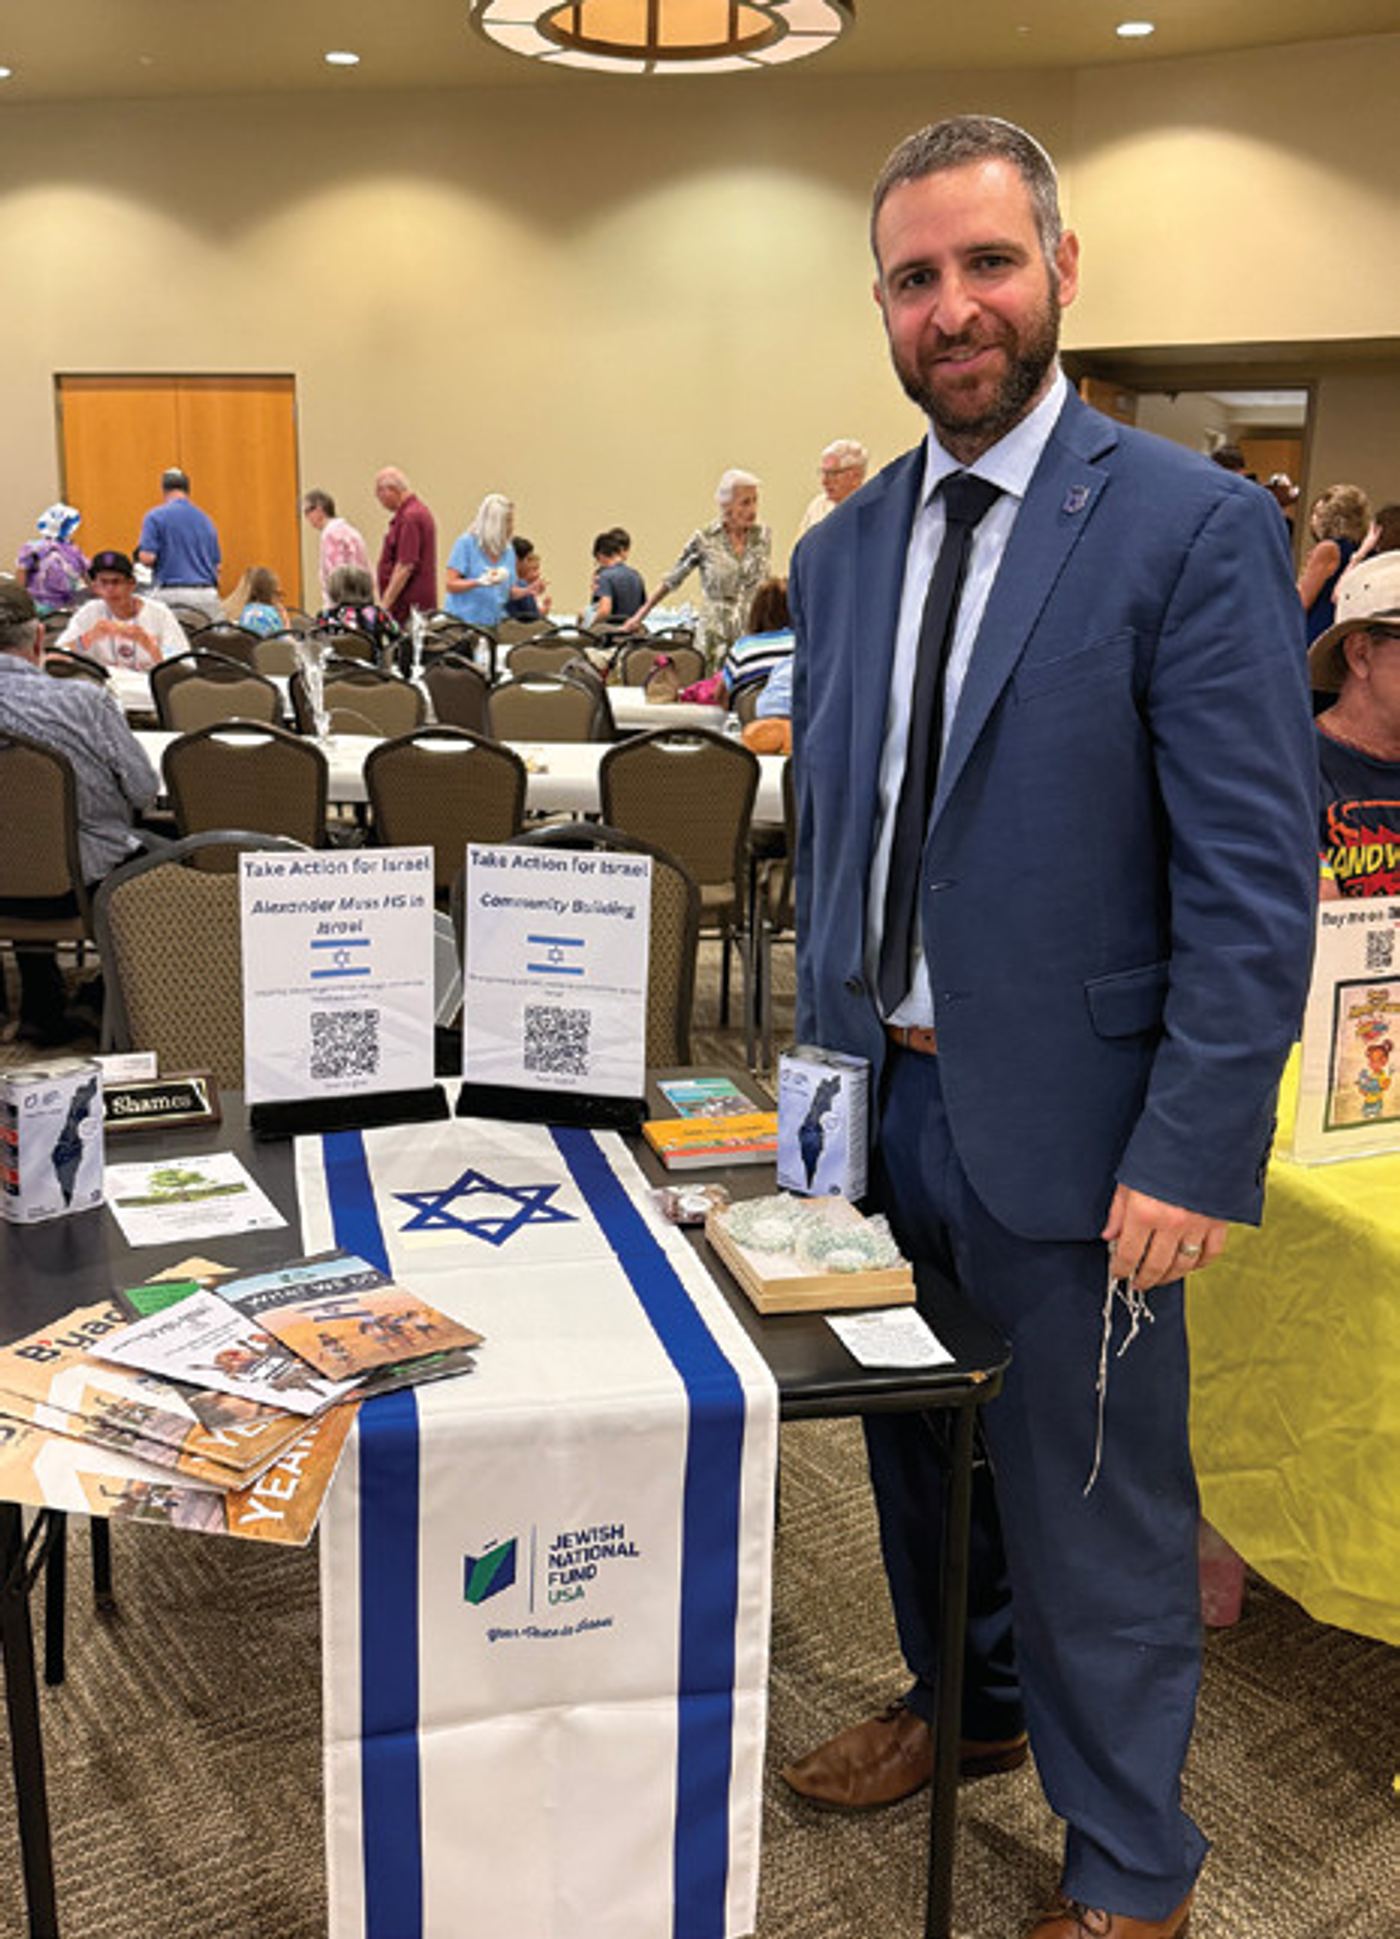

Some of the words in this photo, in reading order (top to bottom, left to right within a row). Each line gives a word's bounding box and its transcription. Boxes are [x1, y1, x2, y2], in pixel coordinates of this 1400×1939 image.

[244, 861, 285, 878] Take
[289, 858, 348, 877] Action
[353, 857, 377, 874] for
[383, 856, 430, 872] Israel
[471, 852, 507, 868] Take
[511, 854, 567, 873] Action
[572, 857, 595, 875] for
[601, 860, 649, 878] Israel
[251, 898, 335, 915] Alexander
[480, 893, 569, 915] Community
[572, 899, 636, 919] Building
[317, 920, 363, 935] Israel
[550, 1523, 626, 1552] JEWISH
[548, 1541, 640, 1570] NATIONAL
[548, 1565, 598, 1587] FUND
[548, 1584, 586, 1606] USA
